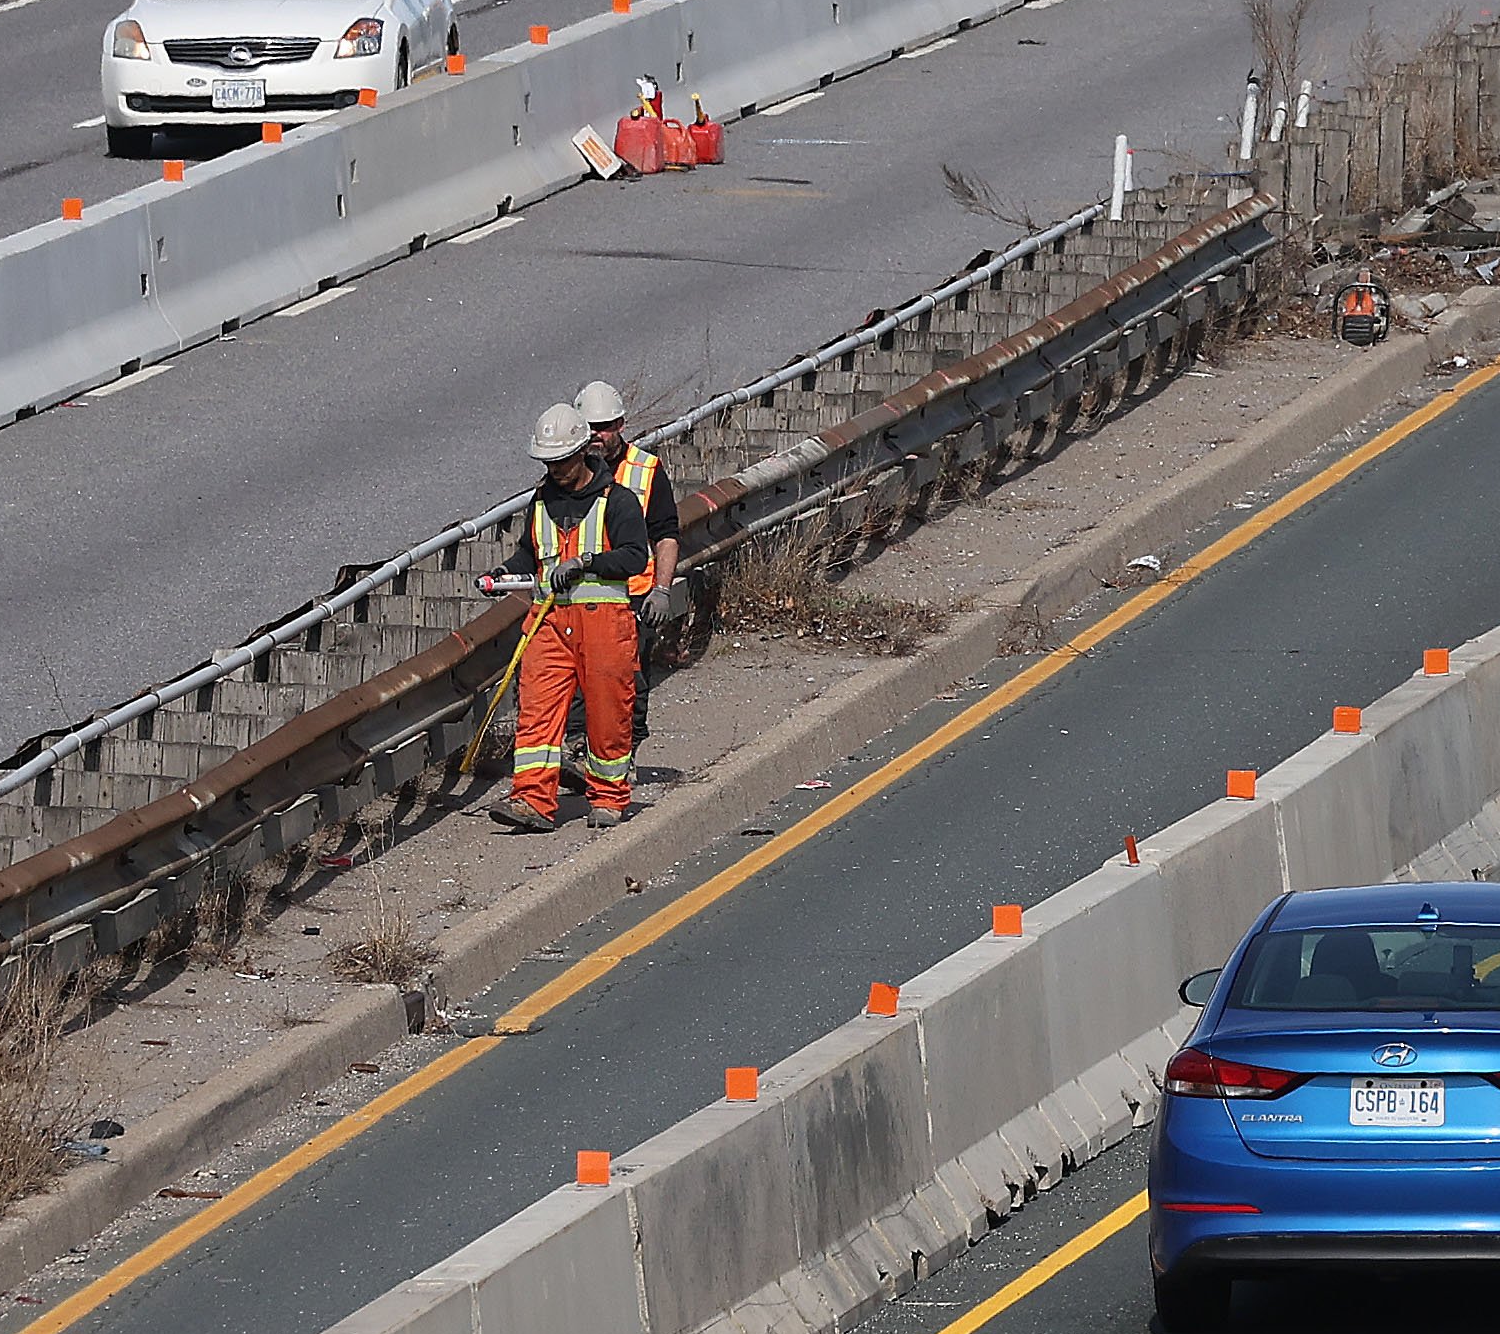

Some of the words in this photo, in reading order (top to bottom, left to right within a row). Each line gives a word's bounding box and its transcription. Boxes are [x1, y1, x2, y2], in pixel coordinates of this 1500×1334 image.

[1354, 1089, 1398, 1113] CSPB
[1409, 1090, 1441, 1114] 164
[1241, 1113, 1304, 1124] ELANTRA
